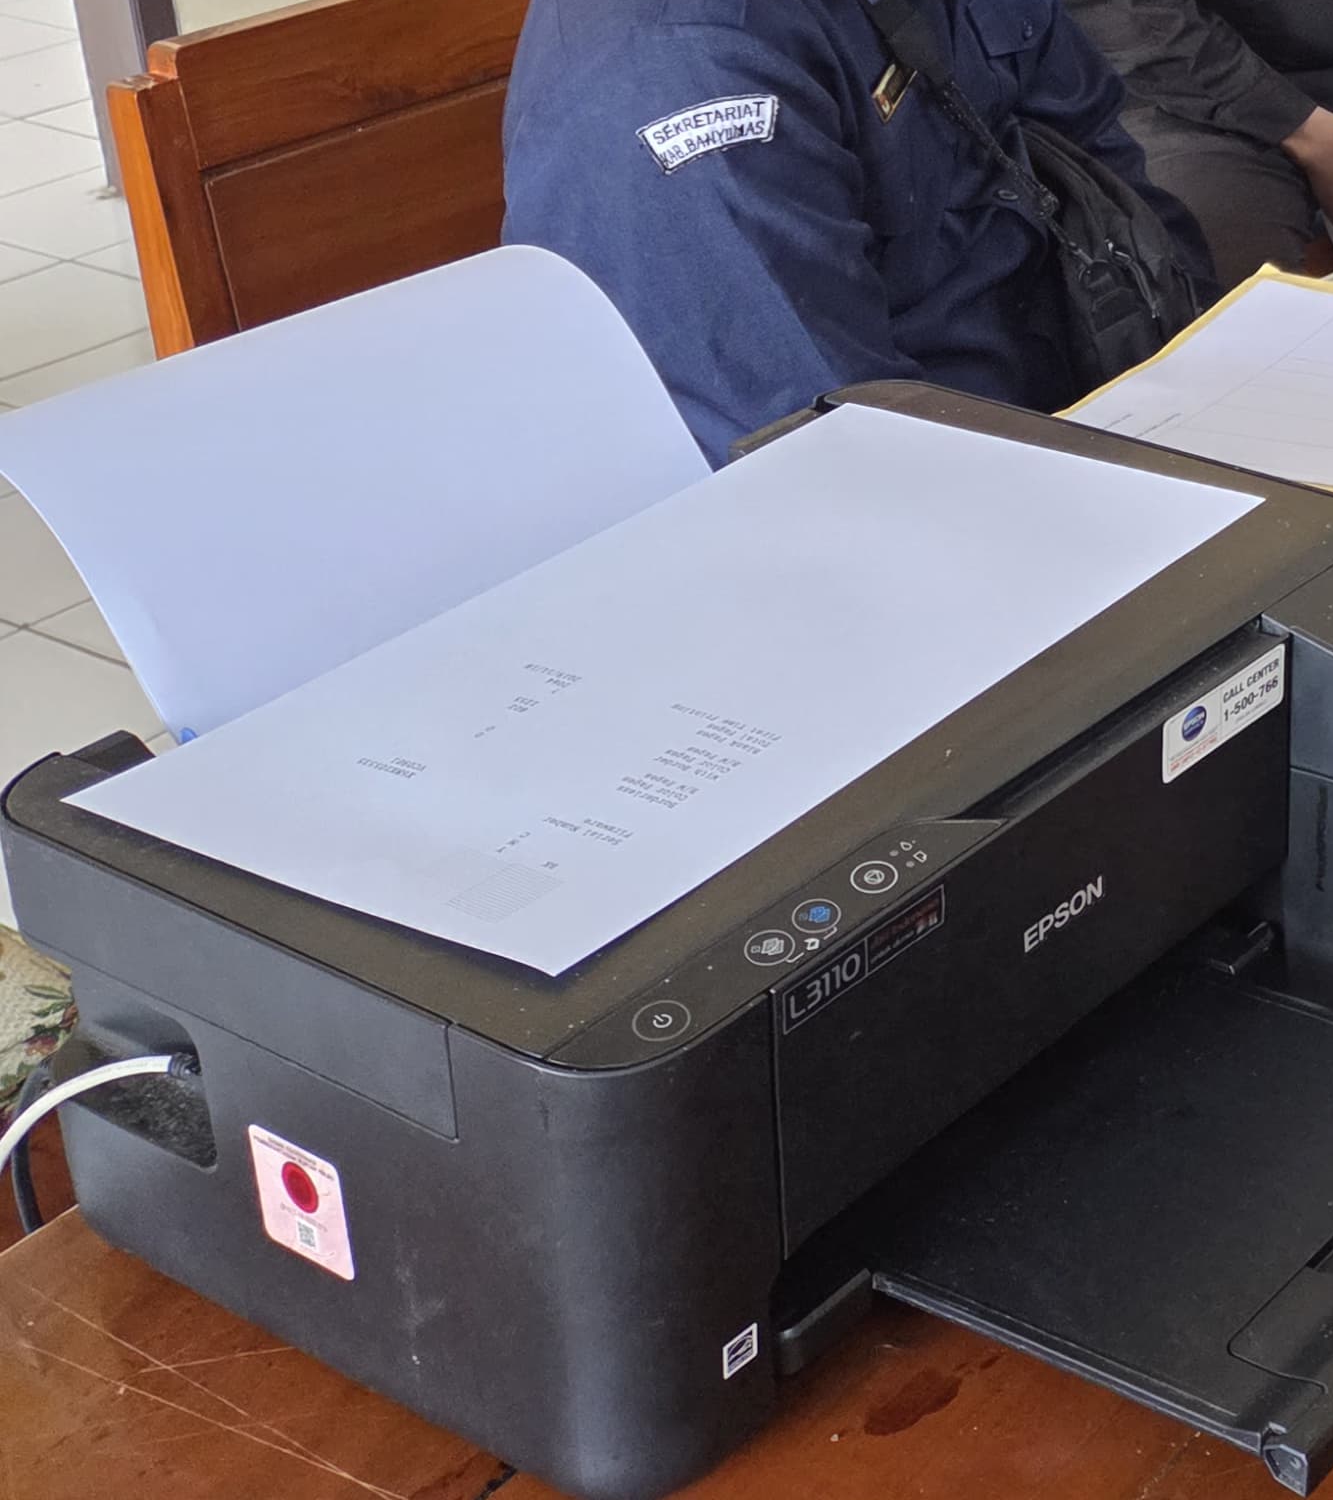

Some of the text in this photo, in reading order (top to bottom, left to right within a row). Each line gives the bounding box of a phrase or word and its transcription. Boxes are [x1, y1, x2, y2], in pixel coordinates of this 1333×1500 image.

[652, 101, 766, 145] SEKRETARIAT
[1223, 658, 1280, 703] CALL CENTER
[1224, 675, 1279, 722] 1-500-766
[671, 703, 719, 721] Printing
[721, 719, 748, 730] Time
[729, 740, 762, 755] Blank
[739, 733, 773, 748] Total
[698, 761, 731, 774] Color
[616, 786, 678, 809] Borderless
[656, 788, 689, 801] Color
[583, 818, 634, 838] Firmware
[1024, 876, 1104, 953] EPSON
[790, 952, 861, 1019] L3110
